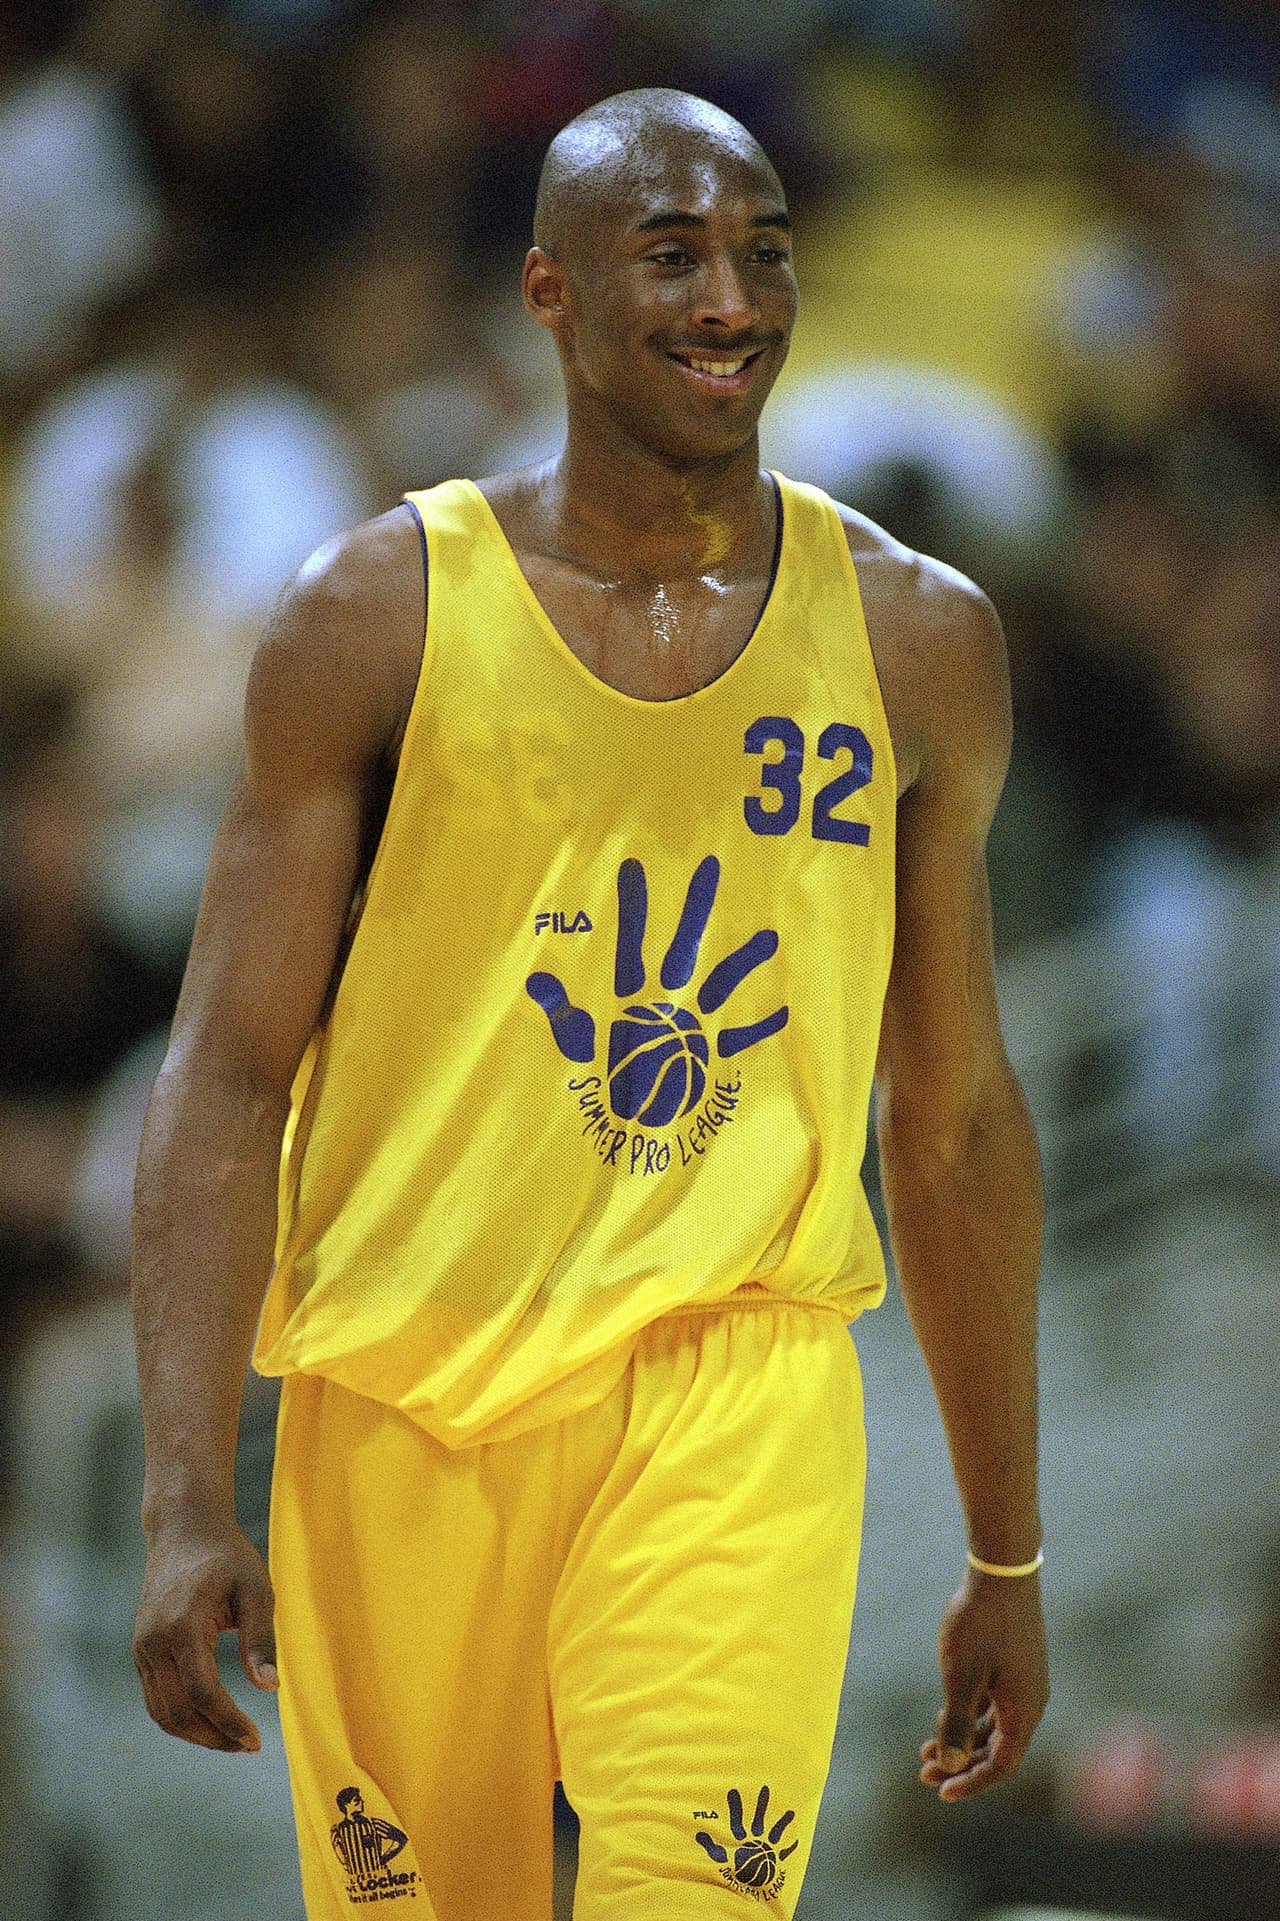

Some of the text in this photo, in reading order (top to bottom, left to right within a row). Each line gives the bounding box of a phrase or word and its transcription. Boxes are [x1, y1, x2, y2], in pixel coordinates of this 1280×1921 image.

[744, 716, 873, 847] 32
[535, 910, 592, 936] FILA
[568, 1076, 627, 1166] SUMMER
[630, 1134, 670, 1176] PRO
[693, 1810, 719, 1820] FILA
